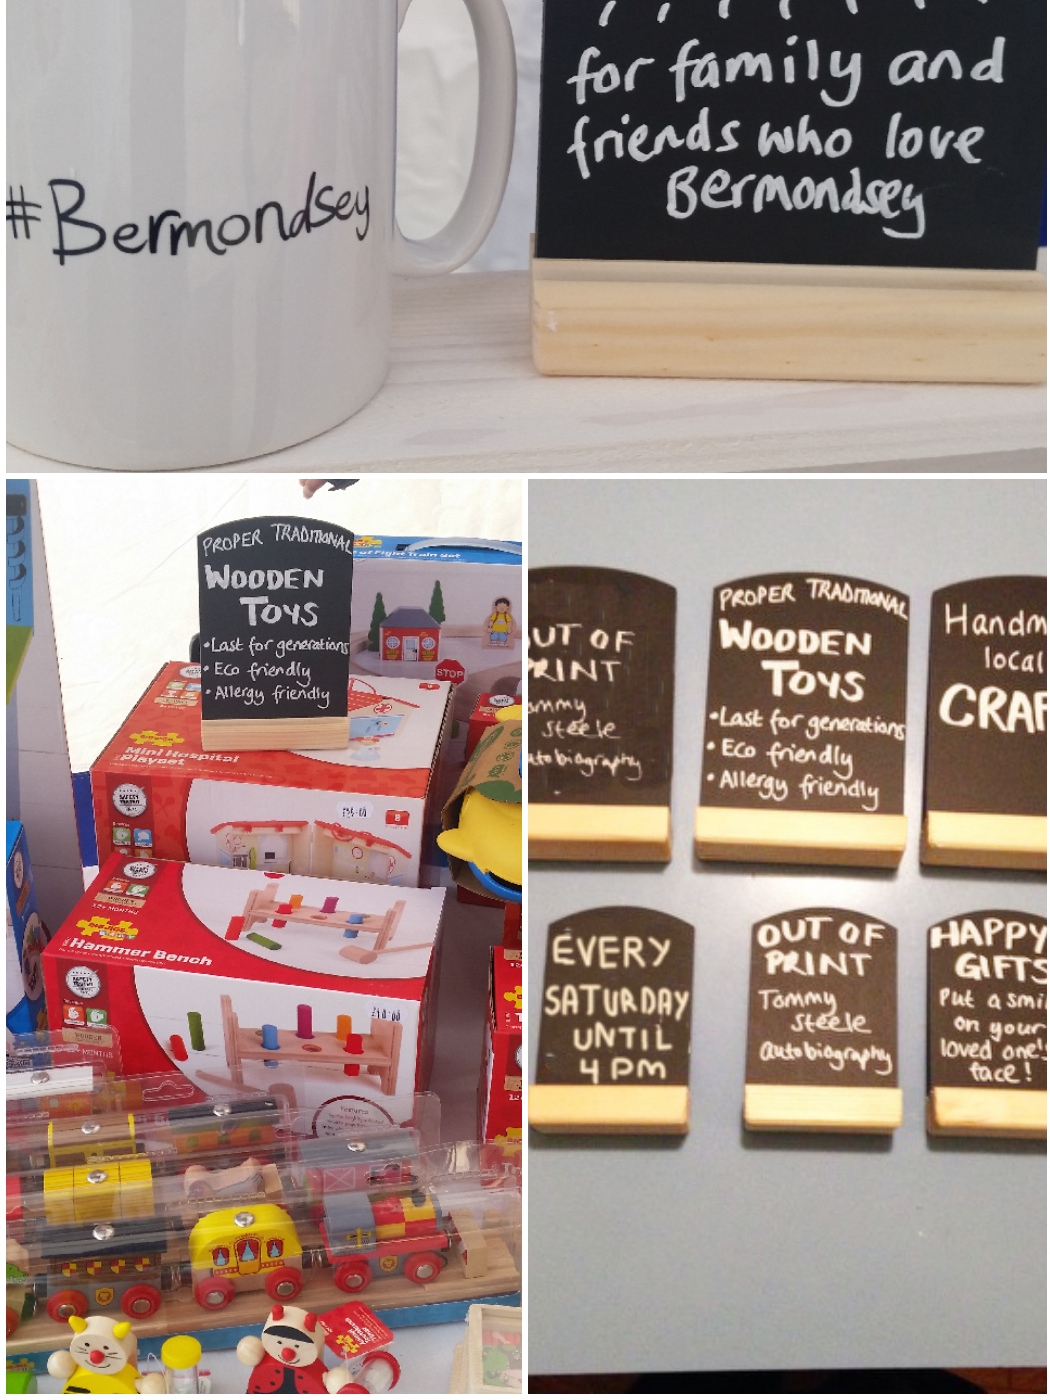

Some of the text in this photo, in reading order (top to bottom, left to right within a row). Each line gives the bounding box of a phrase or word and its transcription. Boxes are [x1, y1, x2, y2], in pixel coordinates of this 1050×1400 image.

[567, 35, 1005, 107] for family and
[567, 107, 985, 179] friends who love
[667, 164, 926, 239] Bermondsey
[6, 171, 371, 266] #Bermondsey
[203, 522, 353, 557] PROPER TRADITIONAL
[204, 564, 324, 589] WOODEN
[720, 577, 908, 620] PROPER TRADITIONAL
[211, 637, 349, 658] Last for generations
[528, 623, 636, 653] UT OF
[719, 618, 872, 656] WOODEN
[215, 662, 311, 687] Eco friendly
[437, 669, 463, 678] STOP
[985, 646, 1043, 674] local
[215, 687, 330, 709] Allergy friendly
[528, 698, 586, 722] ommy
[720, 707, 906, 741] Last for generations
[528, 748, 643, 781] utobiography
[722, 742, 853, 780] Eco friendly
[720, 771, 879, 811] Allergy friendly
[757, 917, 887, 949] OUT OF
[930, 917, 1047, 954] HAPPY
[70, 938, 152, 958] Hammer
[152, 950, 212, 966] Bench
[552, 934, 671, 969] EVERY
[764, 950, 872, 978] PRINT
[545, 984, 689, 1020] SATURDAY
[758, 990, 837, 1016] Tommy
[939, 987, 975, 1008] Put
[987, 993, 1002, 1010] a
[574, 1023, 672, 1051] UNTIL
[954, 1016, 1047, 1042] on your
[760, 1040, 892, 1076] autobiography
[940, 1038, 993, 1060] loved
[580, 1058, 599, 1084] 4
